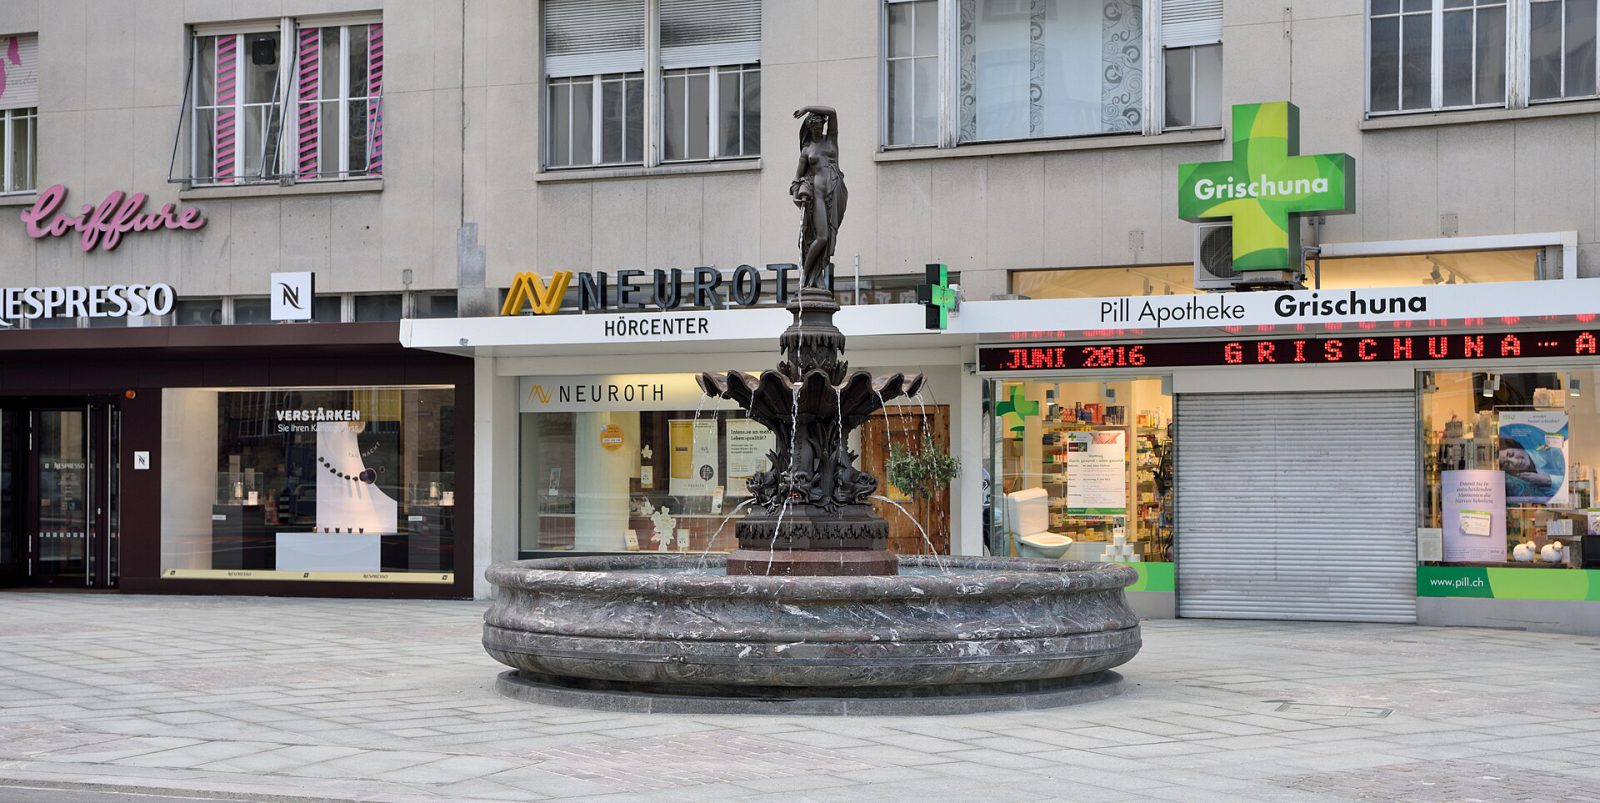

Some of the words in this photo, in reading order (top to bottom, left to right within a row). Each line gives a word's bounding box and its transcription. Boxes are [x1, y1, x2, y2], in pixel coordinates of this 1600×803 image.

[1194, 174, 1328, 200] Grischuna
[1101, 298, 1129, 322] Pill
[1138, 295, 1245, 327] Apotheke
[1274, 291, 1427, 317] Grischuna
[604, 316, 709, 337] HÖRCENTER
[1007, 347, 1066, 368] JUNI
[1082, 345, 1146, 367] 2016
[1225, 335, 1521, 363] GRISCHUNA
[559, 384, 664, 402] NEUROTH
[276, 407, 360, 421] VERSTÄRKEN
[278, 423, 290, 432] Sie
[291, 423, 310, 432] Ihren
[1430, 577, 1484, 589] www.pill.ch
